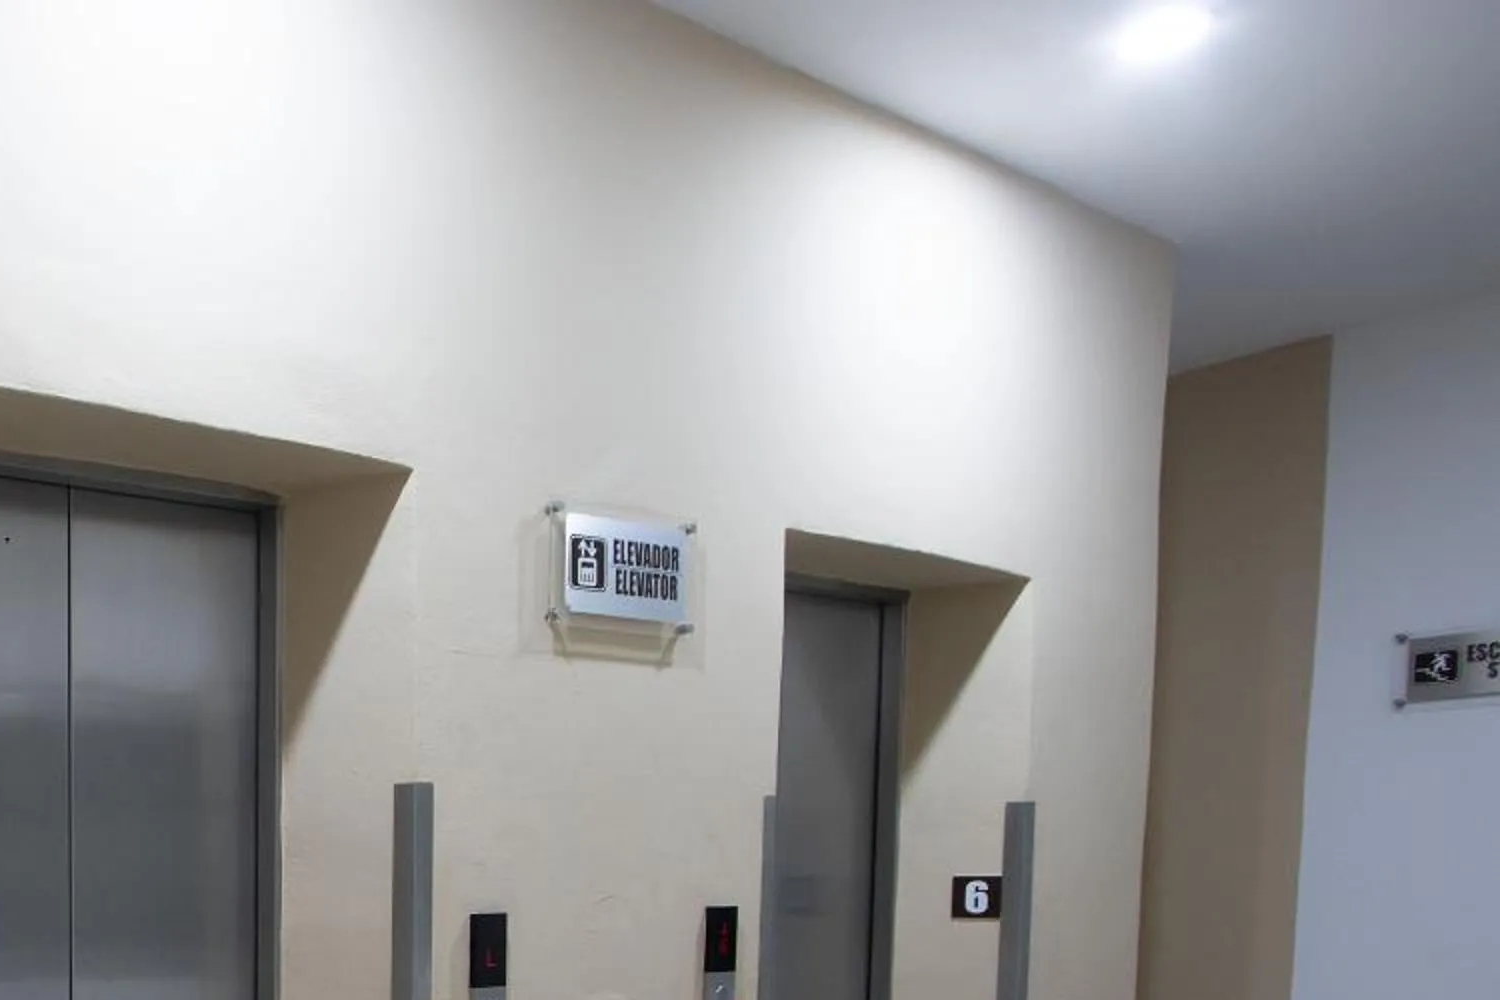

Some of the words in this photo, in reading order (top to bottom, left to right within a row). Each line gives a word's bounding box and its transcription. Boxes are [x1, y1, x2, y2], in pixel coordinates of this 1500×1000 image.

[612, 537, 680, 573] ELEVADOR
[615, 568, 678, 601] ELEVATOR
[964, 879, 989, 914] 6
